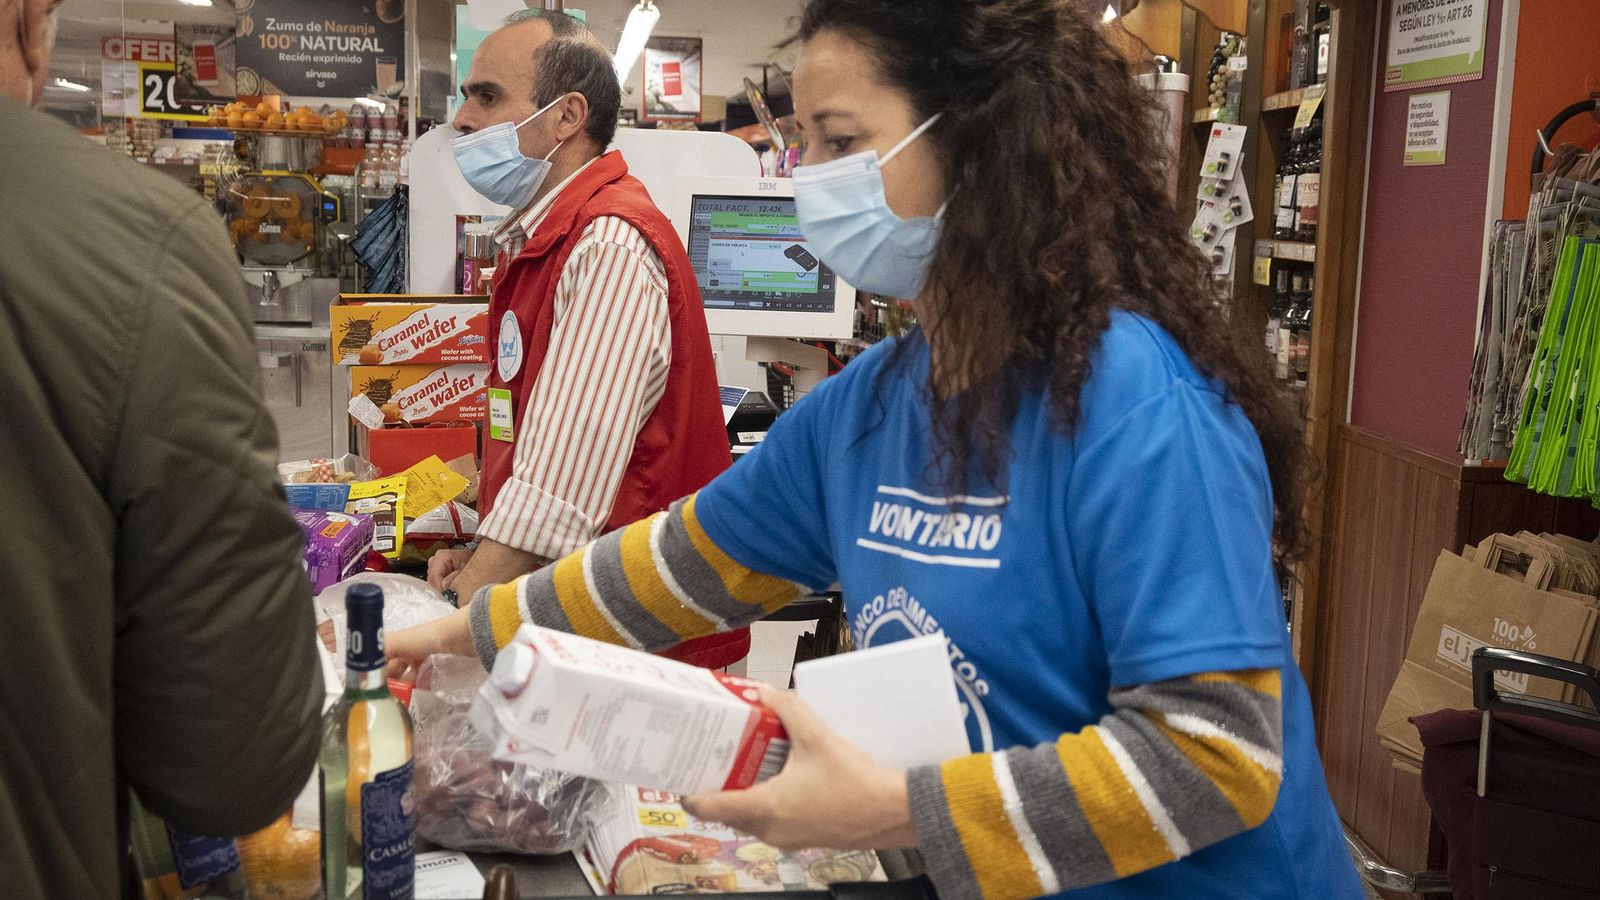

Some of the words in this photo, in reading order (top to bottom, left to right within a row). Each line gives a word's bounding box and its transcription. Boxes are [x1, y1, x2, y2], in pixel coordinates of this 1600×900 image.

[1402, 0, 1435, 15] MENORES
[265, 18, 304, 31] Zumo
[306, 21, 322, 32] de
[324, 20, 376, 36] Naranja
[1399, 13, 1422, 32] SEGÚN
[1422, 14, 1437, 28] LEY
[300, 35, 384, 53] NATURAL
[279, 52, 311, 62] Recién
[313, 55, 363, 64] exprimido
[758, 182, 777, 190] IBM
[697, 203, 725, 212] TOTAL
[726, 204, 750, 212] FACT.
[378, 313, 430, 352] Caramel
[411, 315, 457, 351] Wafer
[397, 372, 449, 410] Caramel
[429, 373, 476, 409] Wafer
[1443, 635, 1460, 656] el
